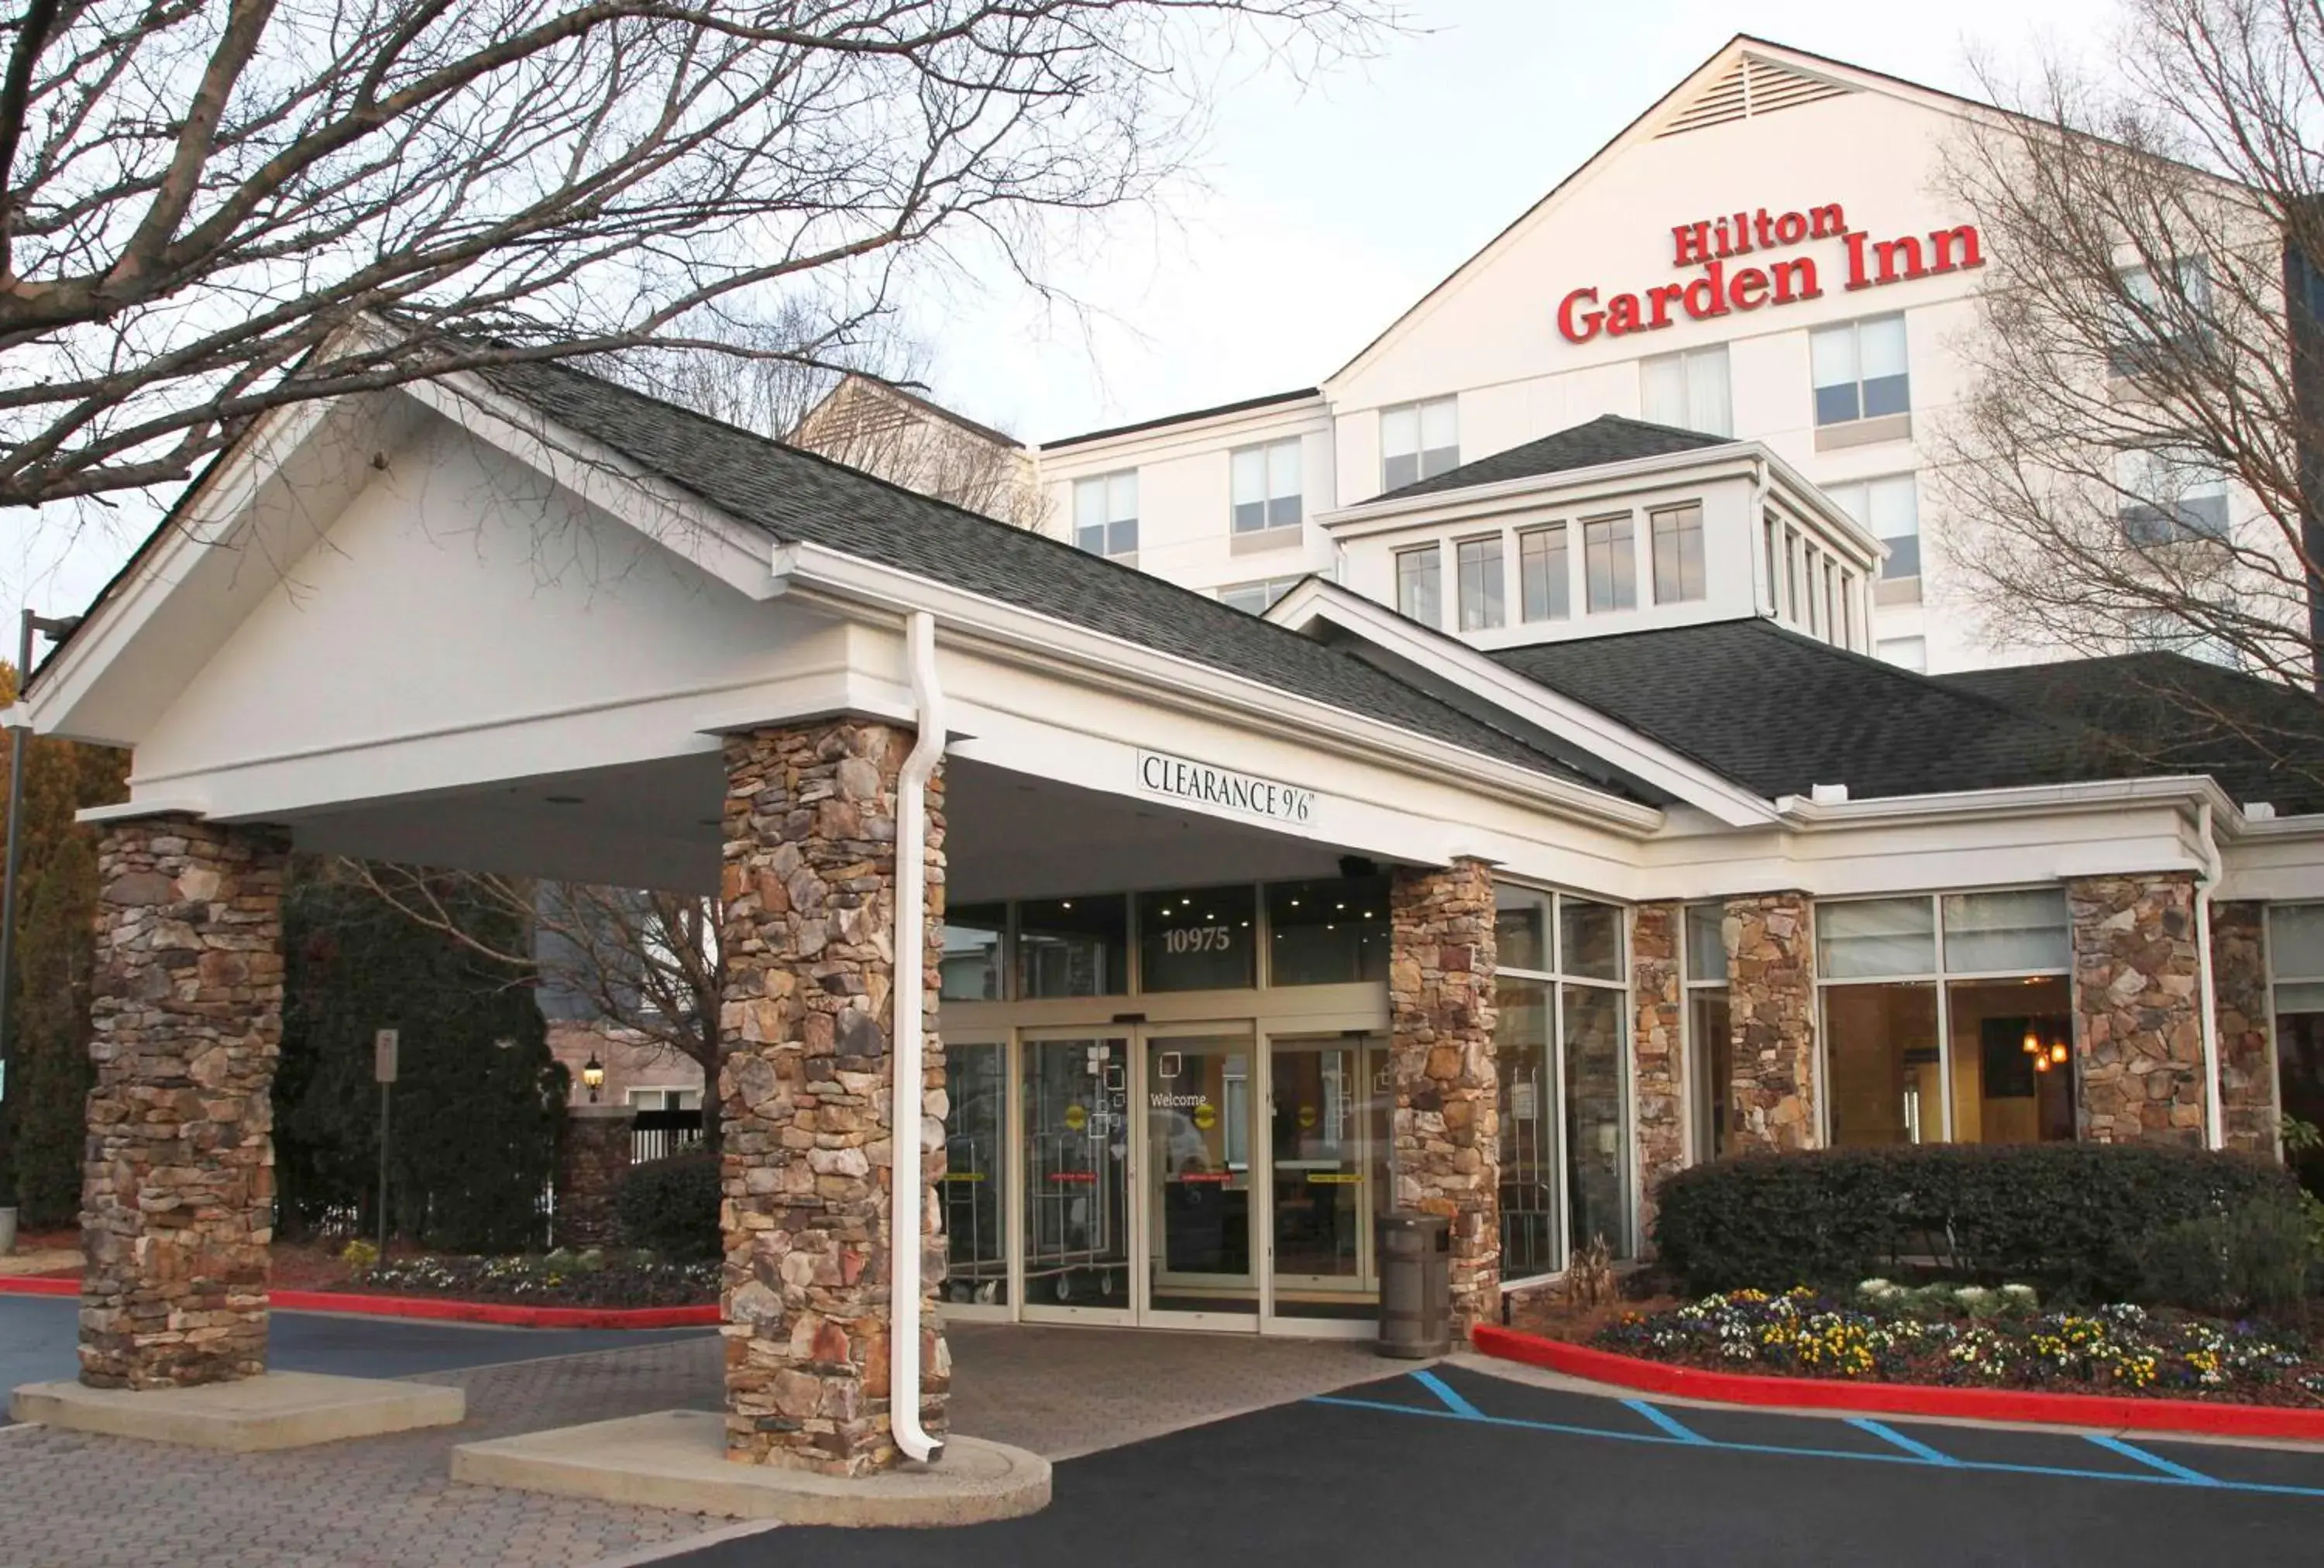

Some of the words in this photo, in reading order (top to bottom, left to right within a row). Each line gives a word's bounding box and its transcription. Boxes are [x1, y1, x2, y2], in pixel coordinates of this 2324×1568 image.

[1671, 203, 1848, 267] Hilton
[1557, 256, 1823, 344] Garden
[1841, 225, 1986, 291] Inn
[1143, 756, 1276, 814] CLEARANCE
[1163, 926, 1230, 954] 10975
[1150, 1091, 1206, 1107] Welcome
